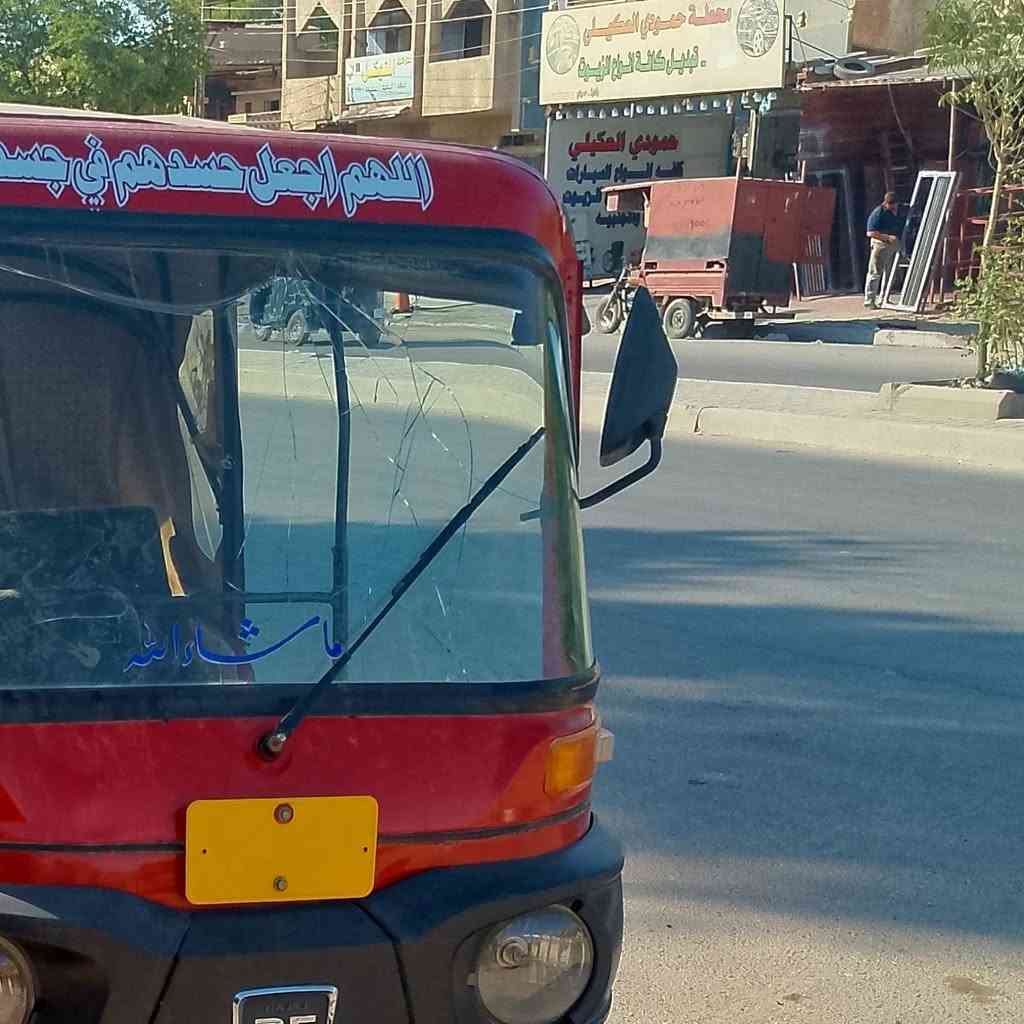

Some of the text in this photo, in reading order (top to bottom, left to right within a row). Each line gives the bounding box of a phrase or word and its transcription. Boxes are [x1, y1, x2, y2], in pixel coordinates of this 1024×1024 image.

[635, 49, 666, 72] كافة
[666, 45, 699, 75] تبديل
[72, 133, 110, 213] في
[111, 144, 247, 207] حسدهم
[246, 142, 339, 211] اجعل
[340, 151, 434, 218] اللهم
